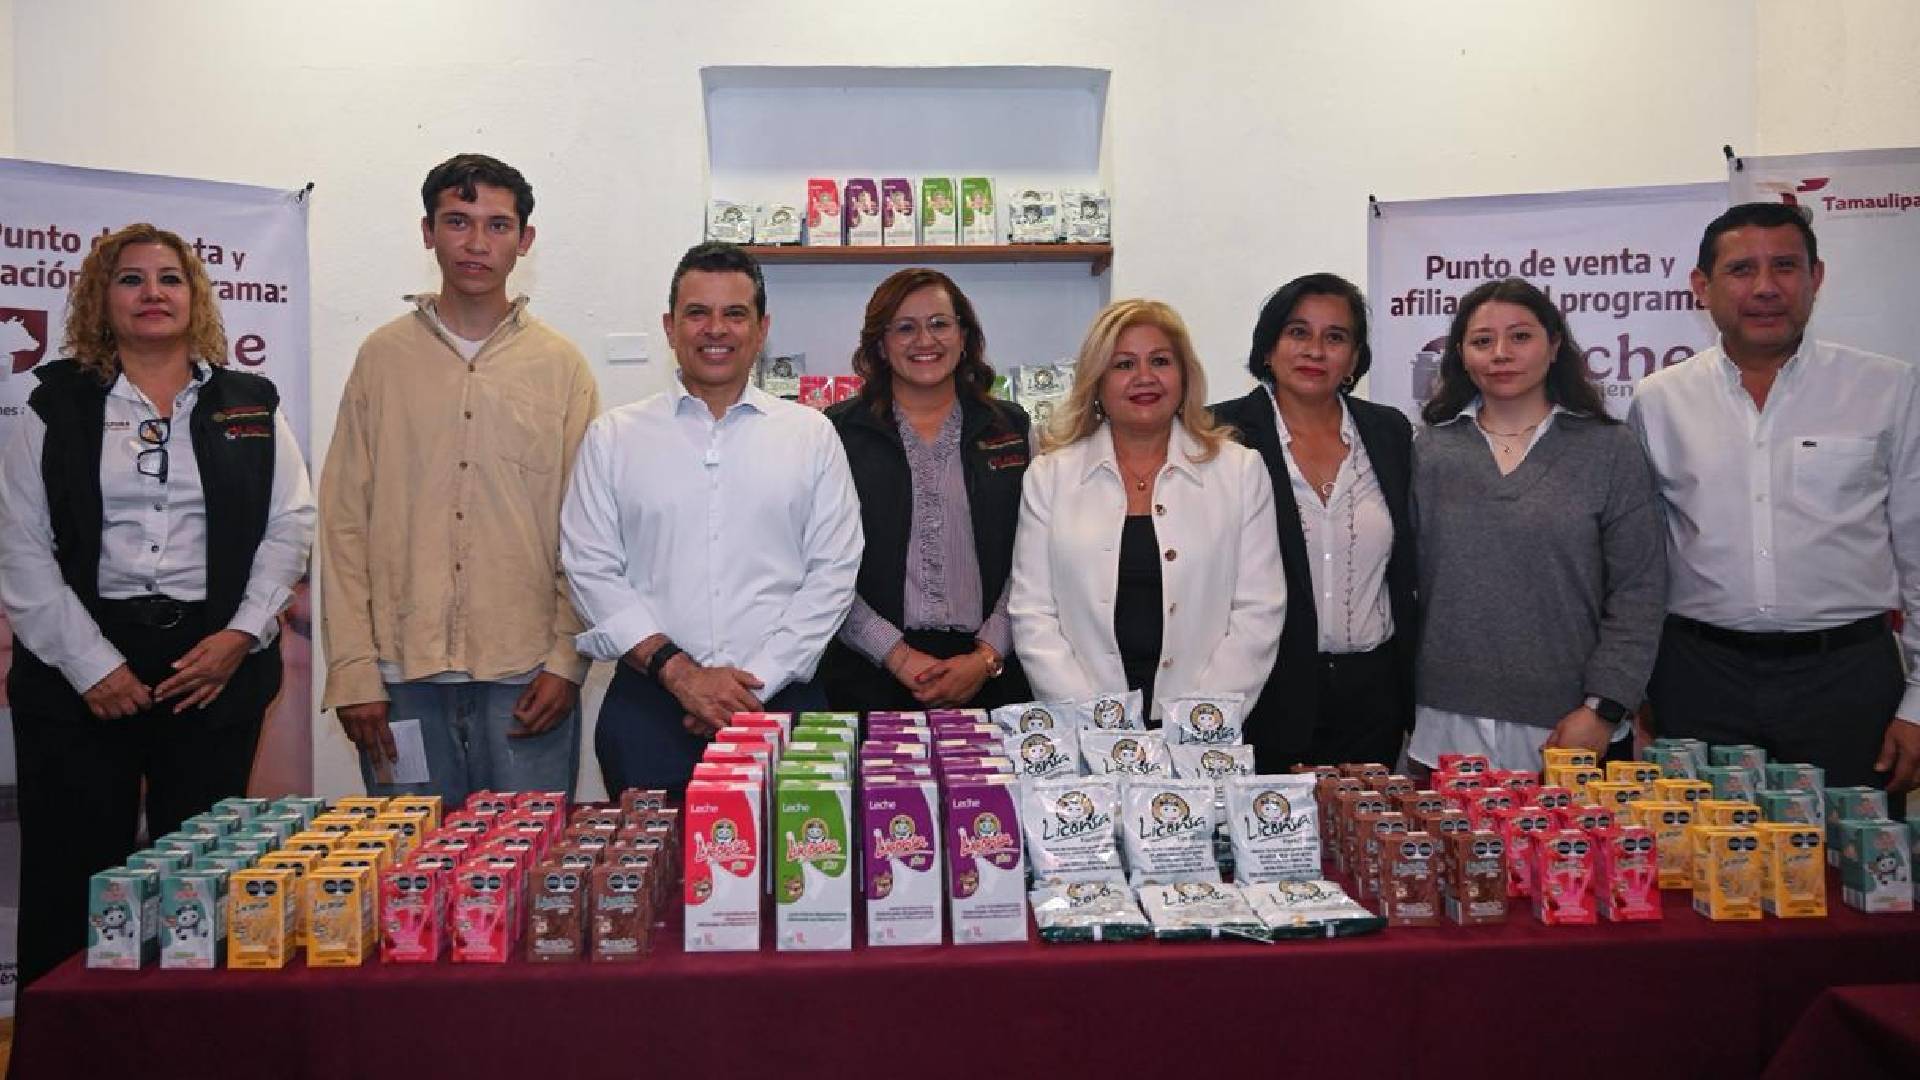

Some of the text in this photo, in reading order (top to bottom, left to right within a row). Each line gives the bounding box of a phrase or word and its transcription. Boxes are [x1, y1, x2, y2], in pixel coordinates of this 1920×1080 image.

[0, 223, 81, 253] unto
[232, 250, 246, 272] y
[1427, 248, 1675, 279] Punto de venta y
[1391, 288, 1457, 316] afilia
[1583, 333, 1695, 381] che
[1023, 753, 1070, 775] iconsa
[690, 803, 719, 813] Leche
[782, 803, 811, 813] Leche
[869, 800, 897, 810] Leche
[952, 799, 981, 808] Leche
[1043, 813, 1111, 840] Liconsa
[1140, 816, 1206, 840] Liconsa
[1244, 814, 1313, 840] Liconsa
